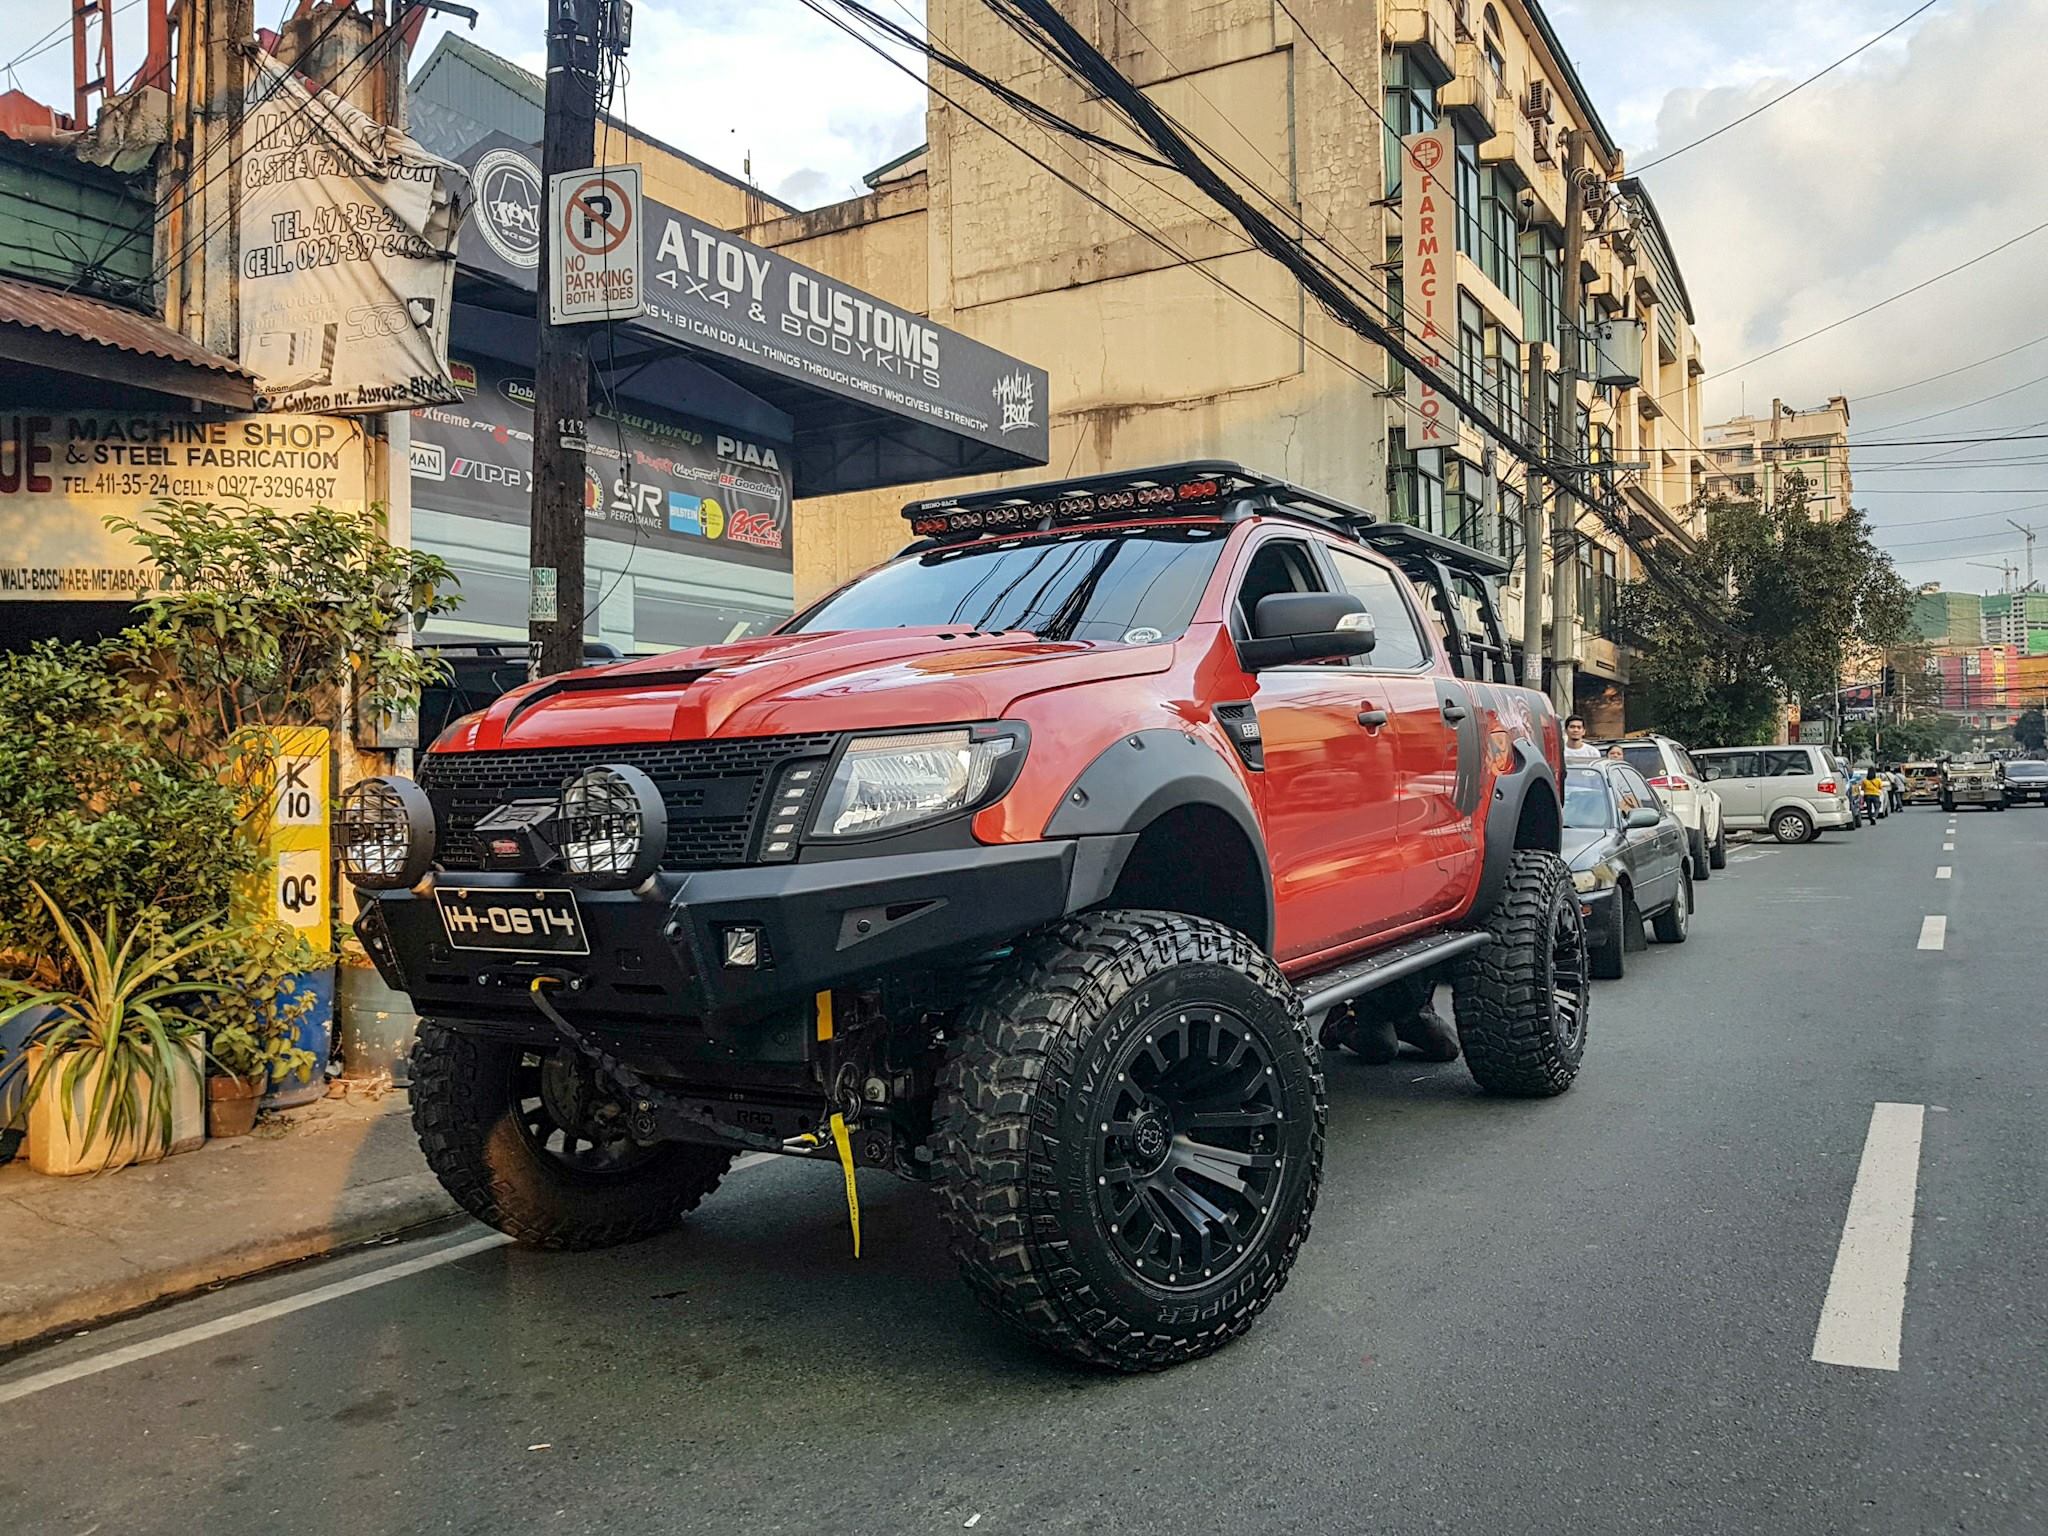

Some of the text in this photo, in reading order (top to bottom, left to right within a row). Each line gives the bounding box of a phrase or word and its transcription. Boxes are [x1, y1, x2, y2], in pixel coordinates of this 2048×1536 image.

[272, 210, 311, 243] TEL.
[244, 245, 294, 279] CELL.
[565, 255, 586, 273] NO
[1417, 175, 1439, 339] FARMACIA
[566, 268, 633, 292] PARKING
[566, 286, 633, 305] BOTH SIDES
[656, 218, 941, 371] ATOY CUSTOMS
[748, 302, 767, 324] &
[781, 313, 941, 388] BODYKITS
[694, 321, 718, 340] CAN
[720, 330, 736, 345] DO
[737, 337, 760, 354] ALL
[762, 345, 801, 368] THINGS
[802, 360, 849, 385] THROUGH
[850, 377, 884, 397] CHRIST
[884, 388, 905, 404] WHO
[905, 396, 929, 413] GIVES
[930, 404, 943, 418] ME
[284, 392, 330, 413] Cubao
[357, 384, 407, 404] Aurora
[69, 417, 335, 448] MACHINE SHOP
[66, 444, 339, 470] & STEEL FABRICATION
[717, 435, 779, 470] PIAA
[63, 477, 94, 494] TEL.
[95, 473, 169, 495] 411-35-24
[218, 475, 336, 499] 0927-3296487
[287, 762, 309, 788] K
[282, 873, 317, 913] QC
[1158, 1251, 1270, 1324] COOPER
